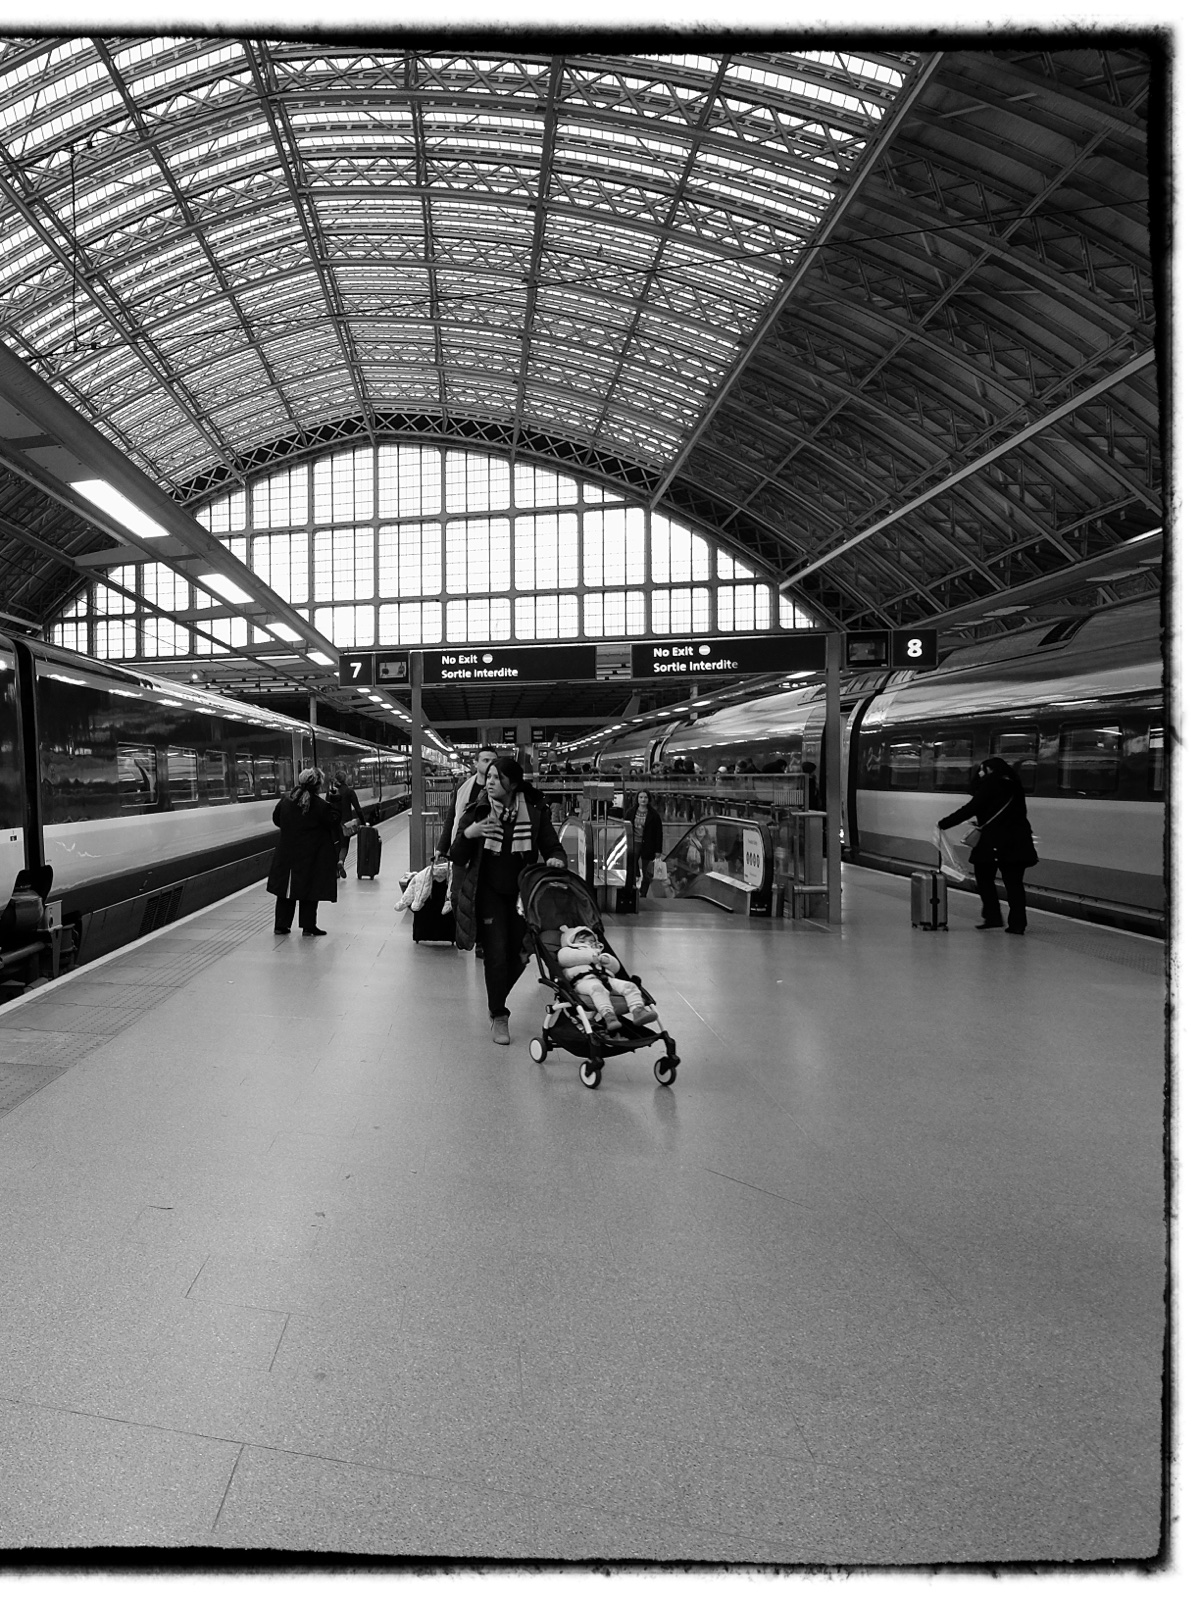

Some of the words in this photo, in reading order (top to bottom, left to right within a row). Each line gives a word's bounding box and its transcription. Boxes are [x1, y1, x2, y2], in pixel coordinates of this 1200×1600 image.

[653, 647, 670, 658] No
[672, 645, 694, 657] Exit
[906, 638, 923, 658] 8
[441, 654, 457, 665] No
[458, 654, 478, 665] Exit
[653, 661, 687, 673] Sortie
[689, 658, 738, 671] Interdite
[350, 662, 363, 679] 7
[441, 668, 472, 680] Sortie
[474, 667, 519, 679] Interdite
